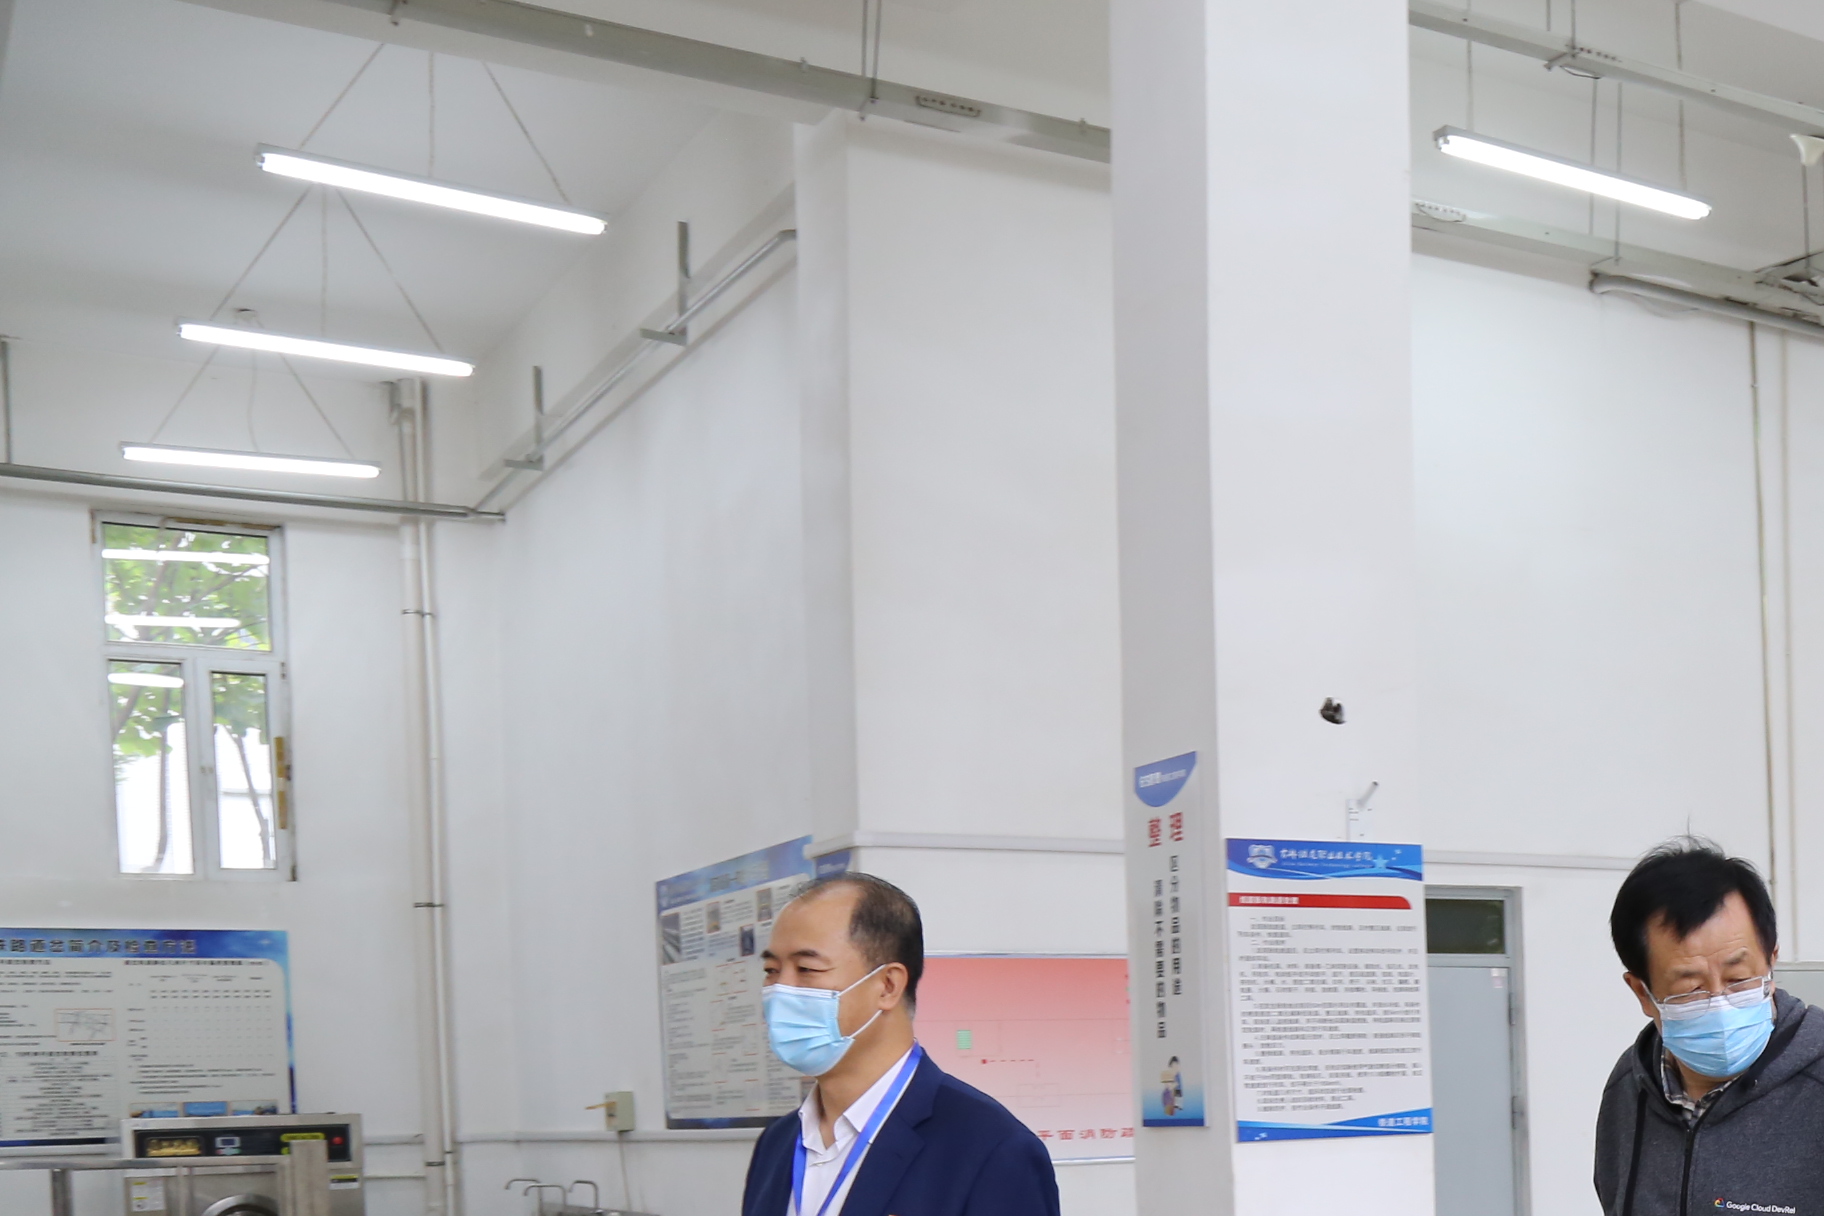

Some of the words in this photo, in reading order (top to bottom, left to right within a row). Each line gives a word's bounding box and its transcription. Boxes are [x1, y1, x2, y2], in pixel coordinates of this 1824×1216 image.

[1726, 1201, 1750, 1212] Google
[1751, 1203, 1771, 1213] Cloud
[1771, 1205, 1796, 1214] DevRel
